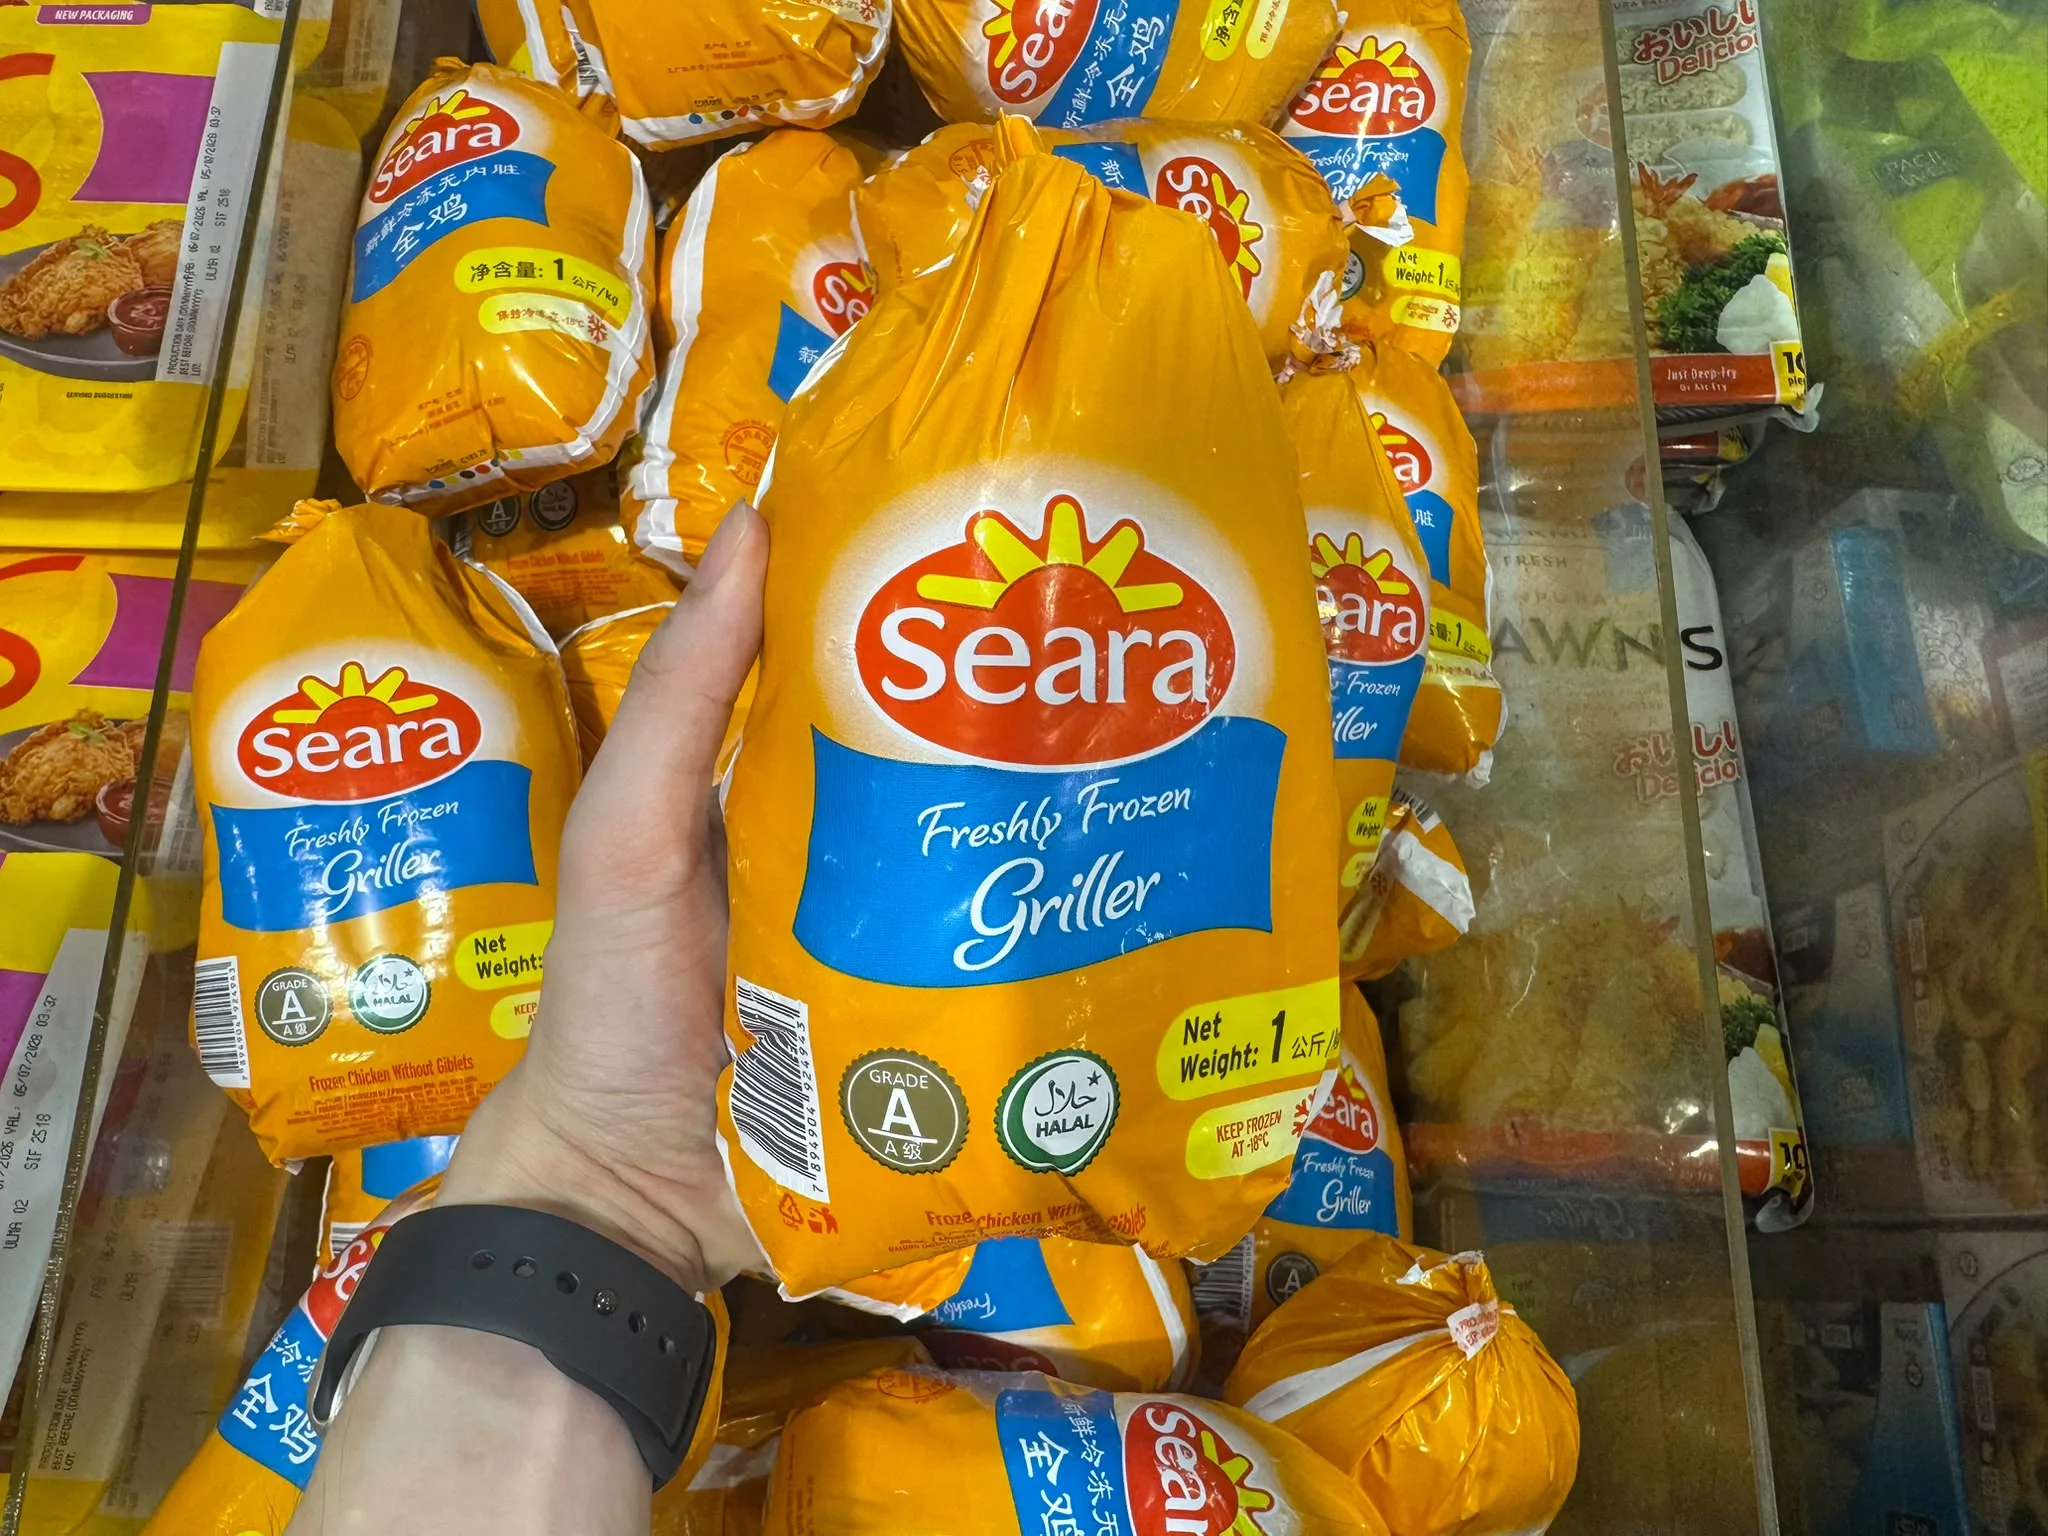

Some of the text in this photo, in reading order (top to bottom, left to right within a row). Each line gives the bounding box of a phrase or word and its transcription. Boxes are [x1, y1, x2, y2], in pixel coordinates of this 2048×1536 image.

[55, 10, 133, 20] NEW PACKAGING
[1213, 0, 1244, 47] 净含
[1106, 16, 1165, 108] 全鸡
[1658, 33, 1759, 84] Delicio
[375, 122, 501, 198] Seara
[1166, 164, 1214, 224] Se
[391, 193, 468, 262] 全鸡
[553, 258, 564, 281] 1
[572, 275, 619, 306] 公斤/kg
[880, 606, 1209, 706] Seara
[1347, 670, 1400, 696] Frozen
[253, 717, 462, 778] Seara
[284, 798, 459, 858] Freshly Frozen
[917, 777, 1190, 857] Freshly Frozen
[311, 842, 441, 917] Griller
[953, 850, 1161, 972] Griller
[474, 934, 506, 956] Net
[476, 953, 543, 979] Weight:
[272, 979, 308, 992] GRADE
[373, 993, 415, 1007] HALAL
[281, 990, 306, 1020] A
[514, 1002, 537, 1015] KEEP
[283, 1025, 292, 1036] A
[1183, 1011, 1222, 1045] Net
[1180, 1047, 1259, 1083] Weight:
[1271, 1010, 1286, 1064] 1
[310, 1054, 474, 1092] Frozen Chicken Without Giblets
[869, 1069, 928, 1089] GRADE
[881, 1088, 922, 1137] A
[1035, 1079, 1096, 1116] حلال
[31, 1112, 52, 1145] 2518
[1036, 1114, 1094, 1138] HALAL
[1216, 1109, 1282, 1143] KEEP FROZEN
[24, 1148, 40, 1171] SIF
[885, 1140, 922, 1160] A 级
[1231, 1139, 1245, 1159] AT
[1302, 1152, 1346, 1178] Freshly
[13, 1198, 29, 1215] 02
[1316, 1178, 1371, 1223] Griller
[925, 1209, 974, 1227] Froze
[232, 1373, 318, 1465] 全鸡
